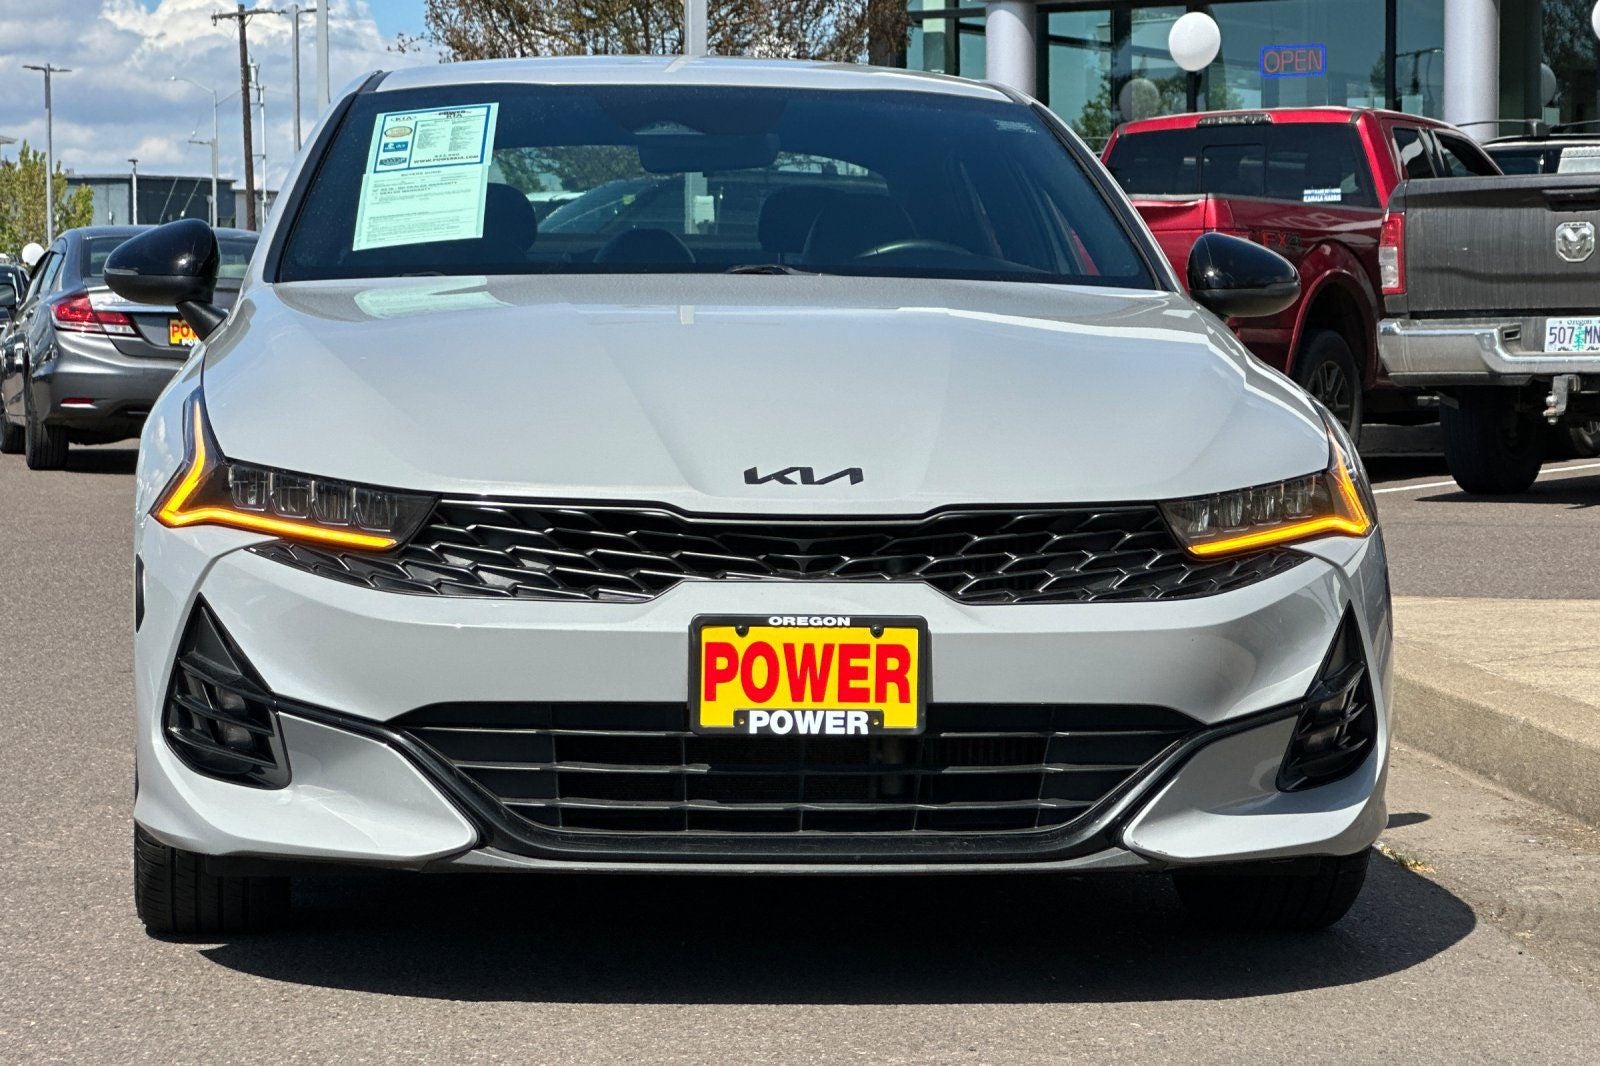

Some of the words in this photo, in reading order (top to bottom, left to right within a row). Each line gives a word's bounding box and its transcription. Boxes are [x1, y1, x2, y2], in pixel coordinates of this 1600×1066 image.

[1264, 50, 1322, 73] OPEN
[1549, 326, 1575, 344] 507
[768, 616, 851, 627] OREGON
[704, 640, 911, 704] POWER
[749, 709, 869, 735] POWER
